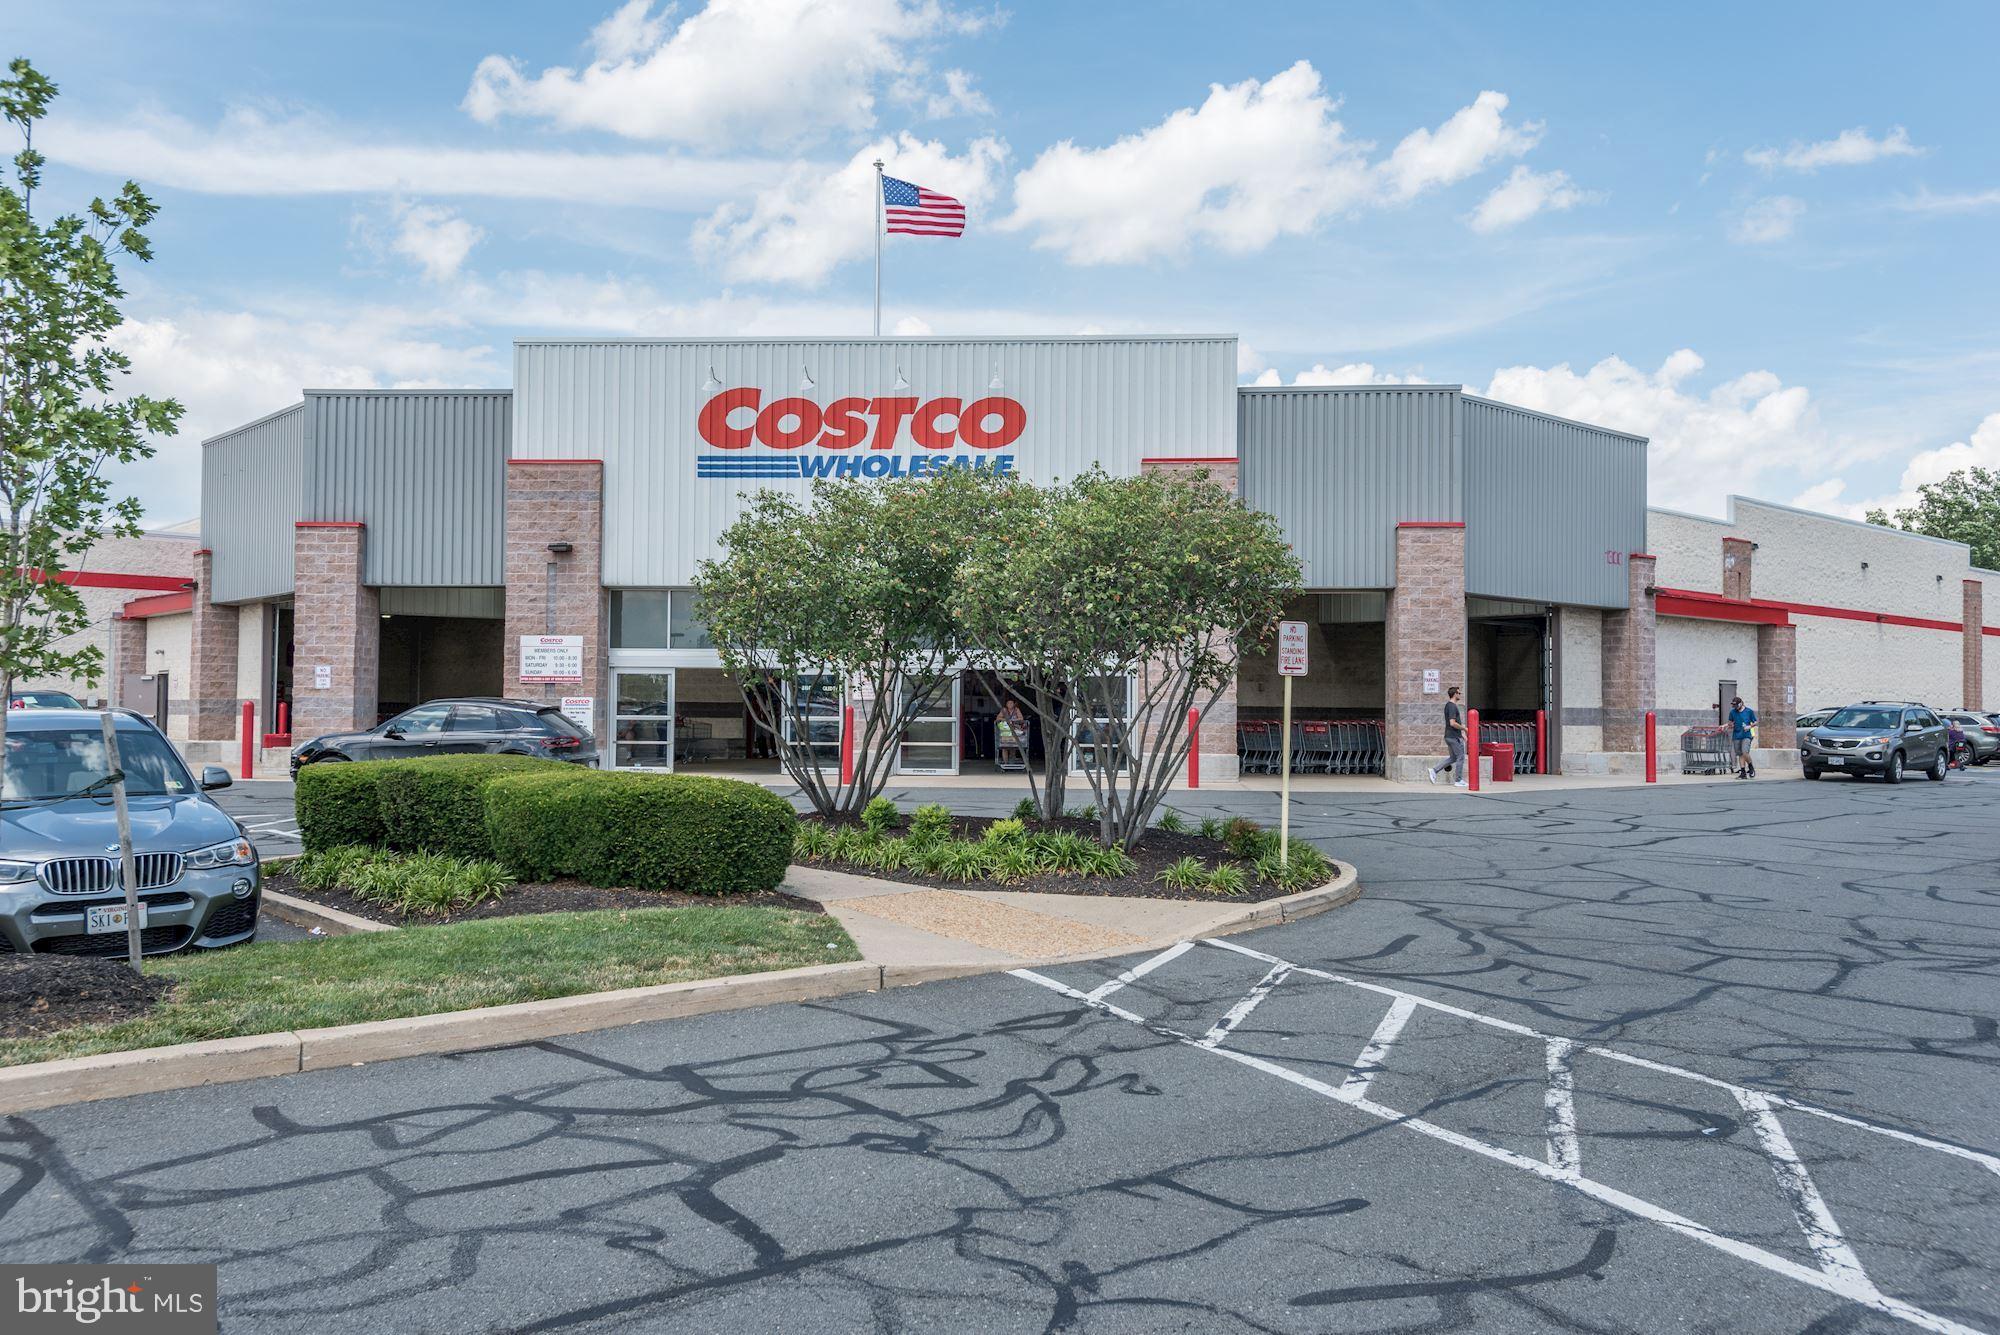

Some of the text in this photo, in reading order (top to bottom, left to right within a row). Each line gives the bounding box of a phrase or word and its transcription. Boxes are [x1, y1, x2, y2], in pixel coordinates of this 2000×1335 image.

[697, 387, 1027, 450] COSTCO
[1292, 656, 1305, 664] LANE
[103, 904, 128, 913] VIRGINI
